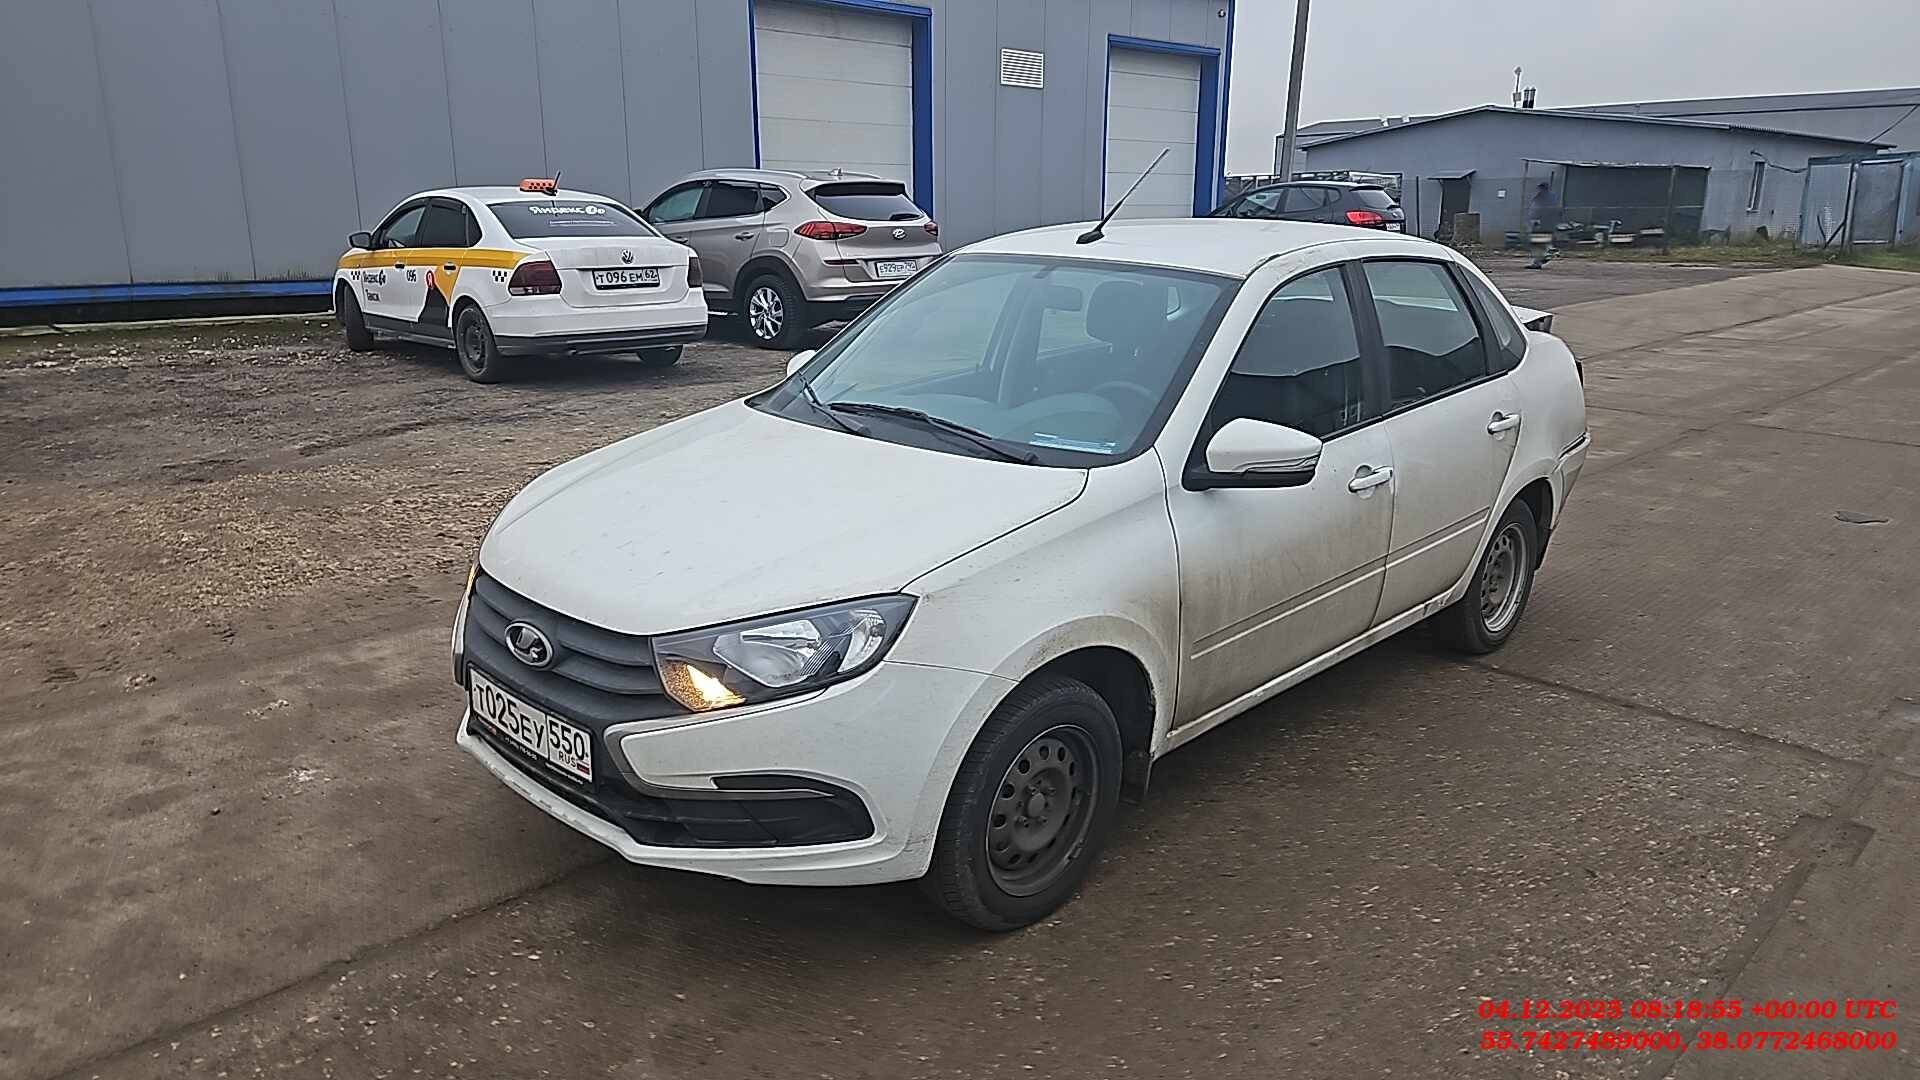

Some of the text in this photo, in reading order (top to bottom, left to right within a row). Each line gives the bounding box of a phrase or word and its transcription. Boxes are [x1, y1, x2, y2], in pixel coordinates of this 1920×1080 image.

[645, 269, 655, 279] 62
[549, 719, 585, 761] 550
[558, 750, 577, 768] RUS
